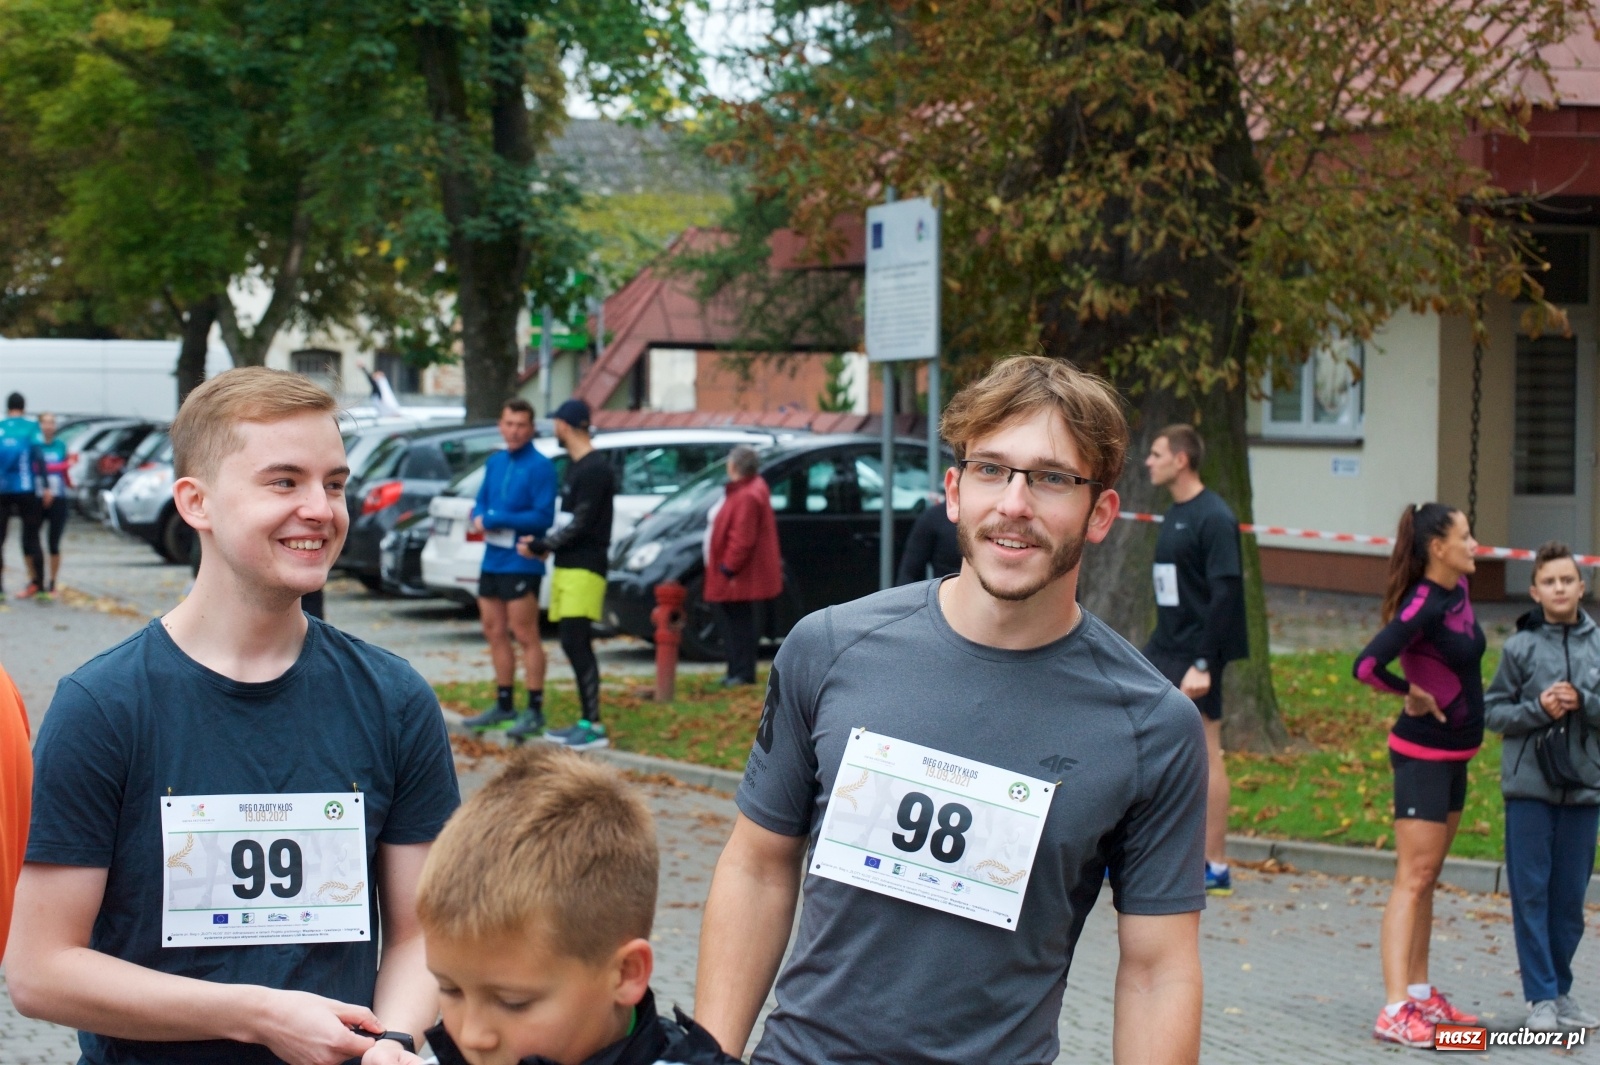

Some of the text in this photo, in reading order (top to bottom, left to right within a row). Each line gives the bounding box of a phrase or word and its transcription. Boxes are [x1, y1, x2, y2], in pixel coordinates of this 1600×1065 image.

[922, 756, 937, 767] BIEG
[943, 762, 962, 774] ZŁOTY
[962, 768, 978, 779] KŁOS
[926, 764, 970, 787] 19.09.2021
[1039, 754, 1079, 774] 4F
[239, 804, 252, 812] BIEG
[278, 803, 293, 811] KŁOS
[245, 811, 287, 822] 19.09.2021
[891, 791, 973, 864] 98
[230, 838, 303, 900] 99
